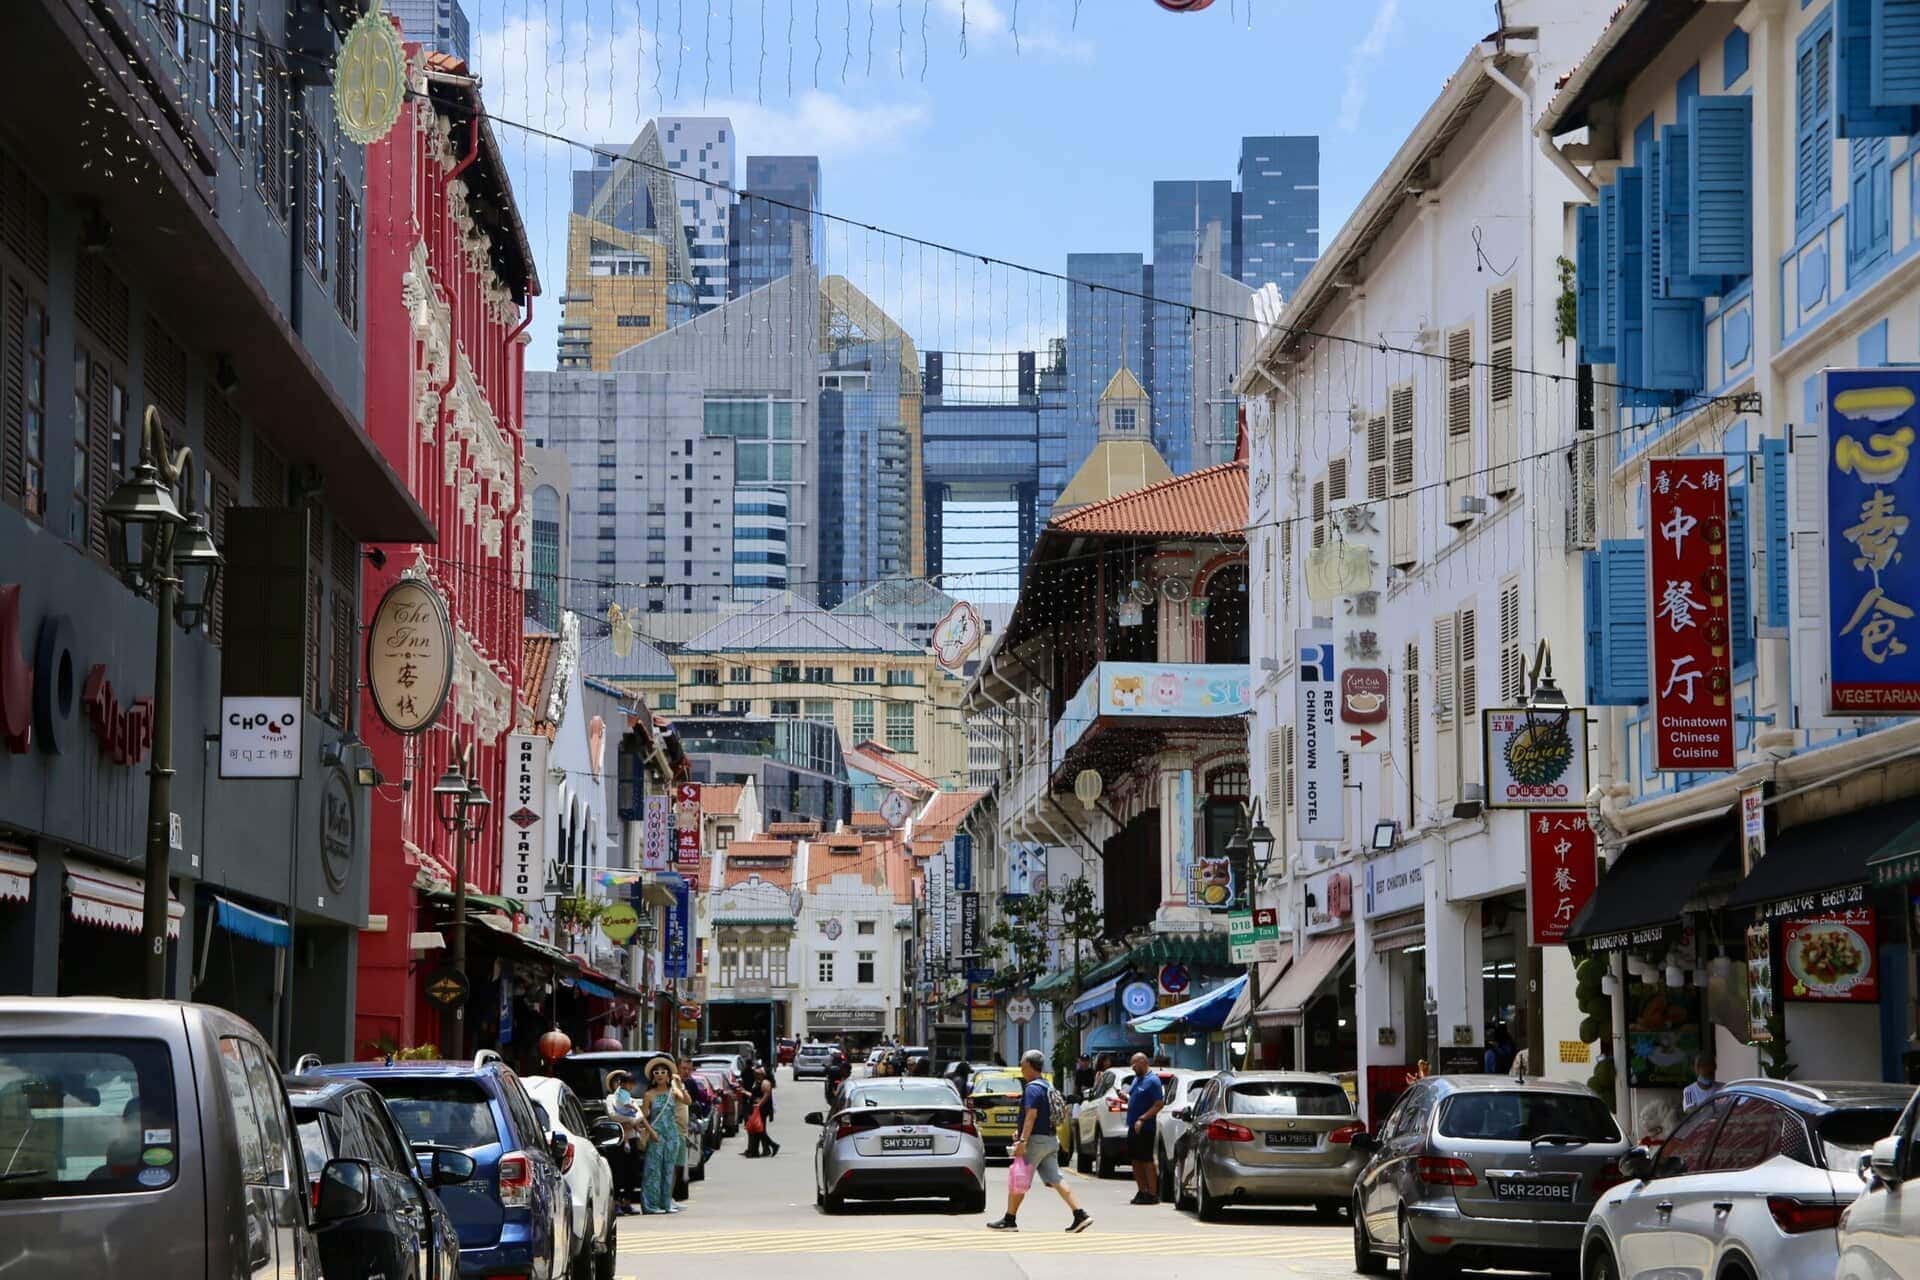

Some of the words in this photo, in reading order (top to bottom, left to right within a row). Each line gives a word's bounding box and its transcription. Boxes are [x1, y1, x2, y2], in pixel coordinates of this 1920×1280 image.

[1653, 470, 1723, 494] 唐人街
[1834, 387, 1915, 664] 一心素食
[392, 601, 430, 624] The
[1656, 506, 1707, 704] 中餐厅
[386, 627, 430, 648] Inn
[1323, 690, 1333, 725] REST
[1306, 690, 1317, 770] CHINATOWN
[1662, 716, 1727, 727] Chinatown
[1670, 732, 1720, 743] Chinese
[1672, 747, 1719, 758] Cuisine
[520, 742, 532, 804] GALAXY
[1307, 781, 1318, 825] HOTEL
[517, 831, 530, 895] TATTOO
[1554, 838, 1576, 920] 中餐厅
[1231, 921, 1251, 931] D18
[1259, 926, 1274, 936] Taxi
[154, 936, 162, 954] 8
